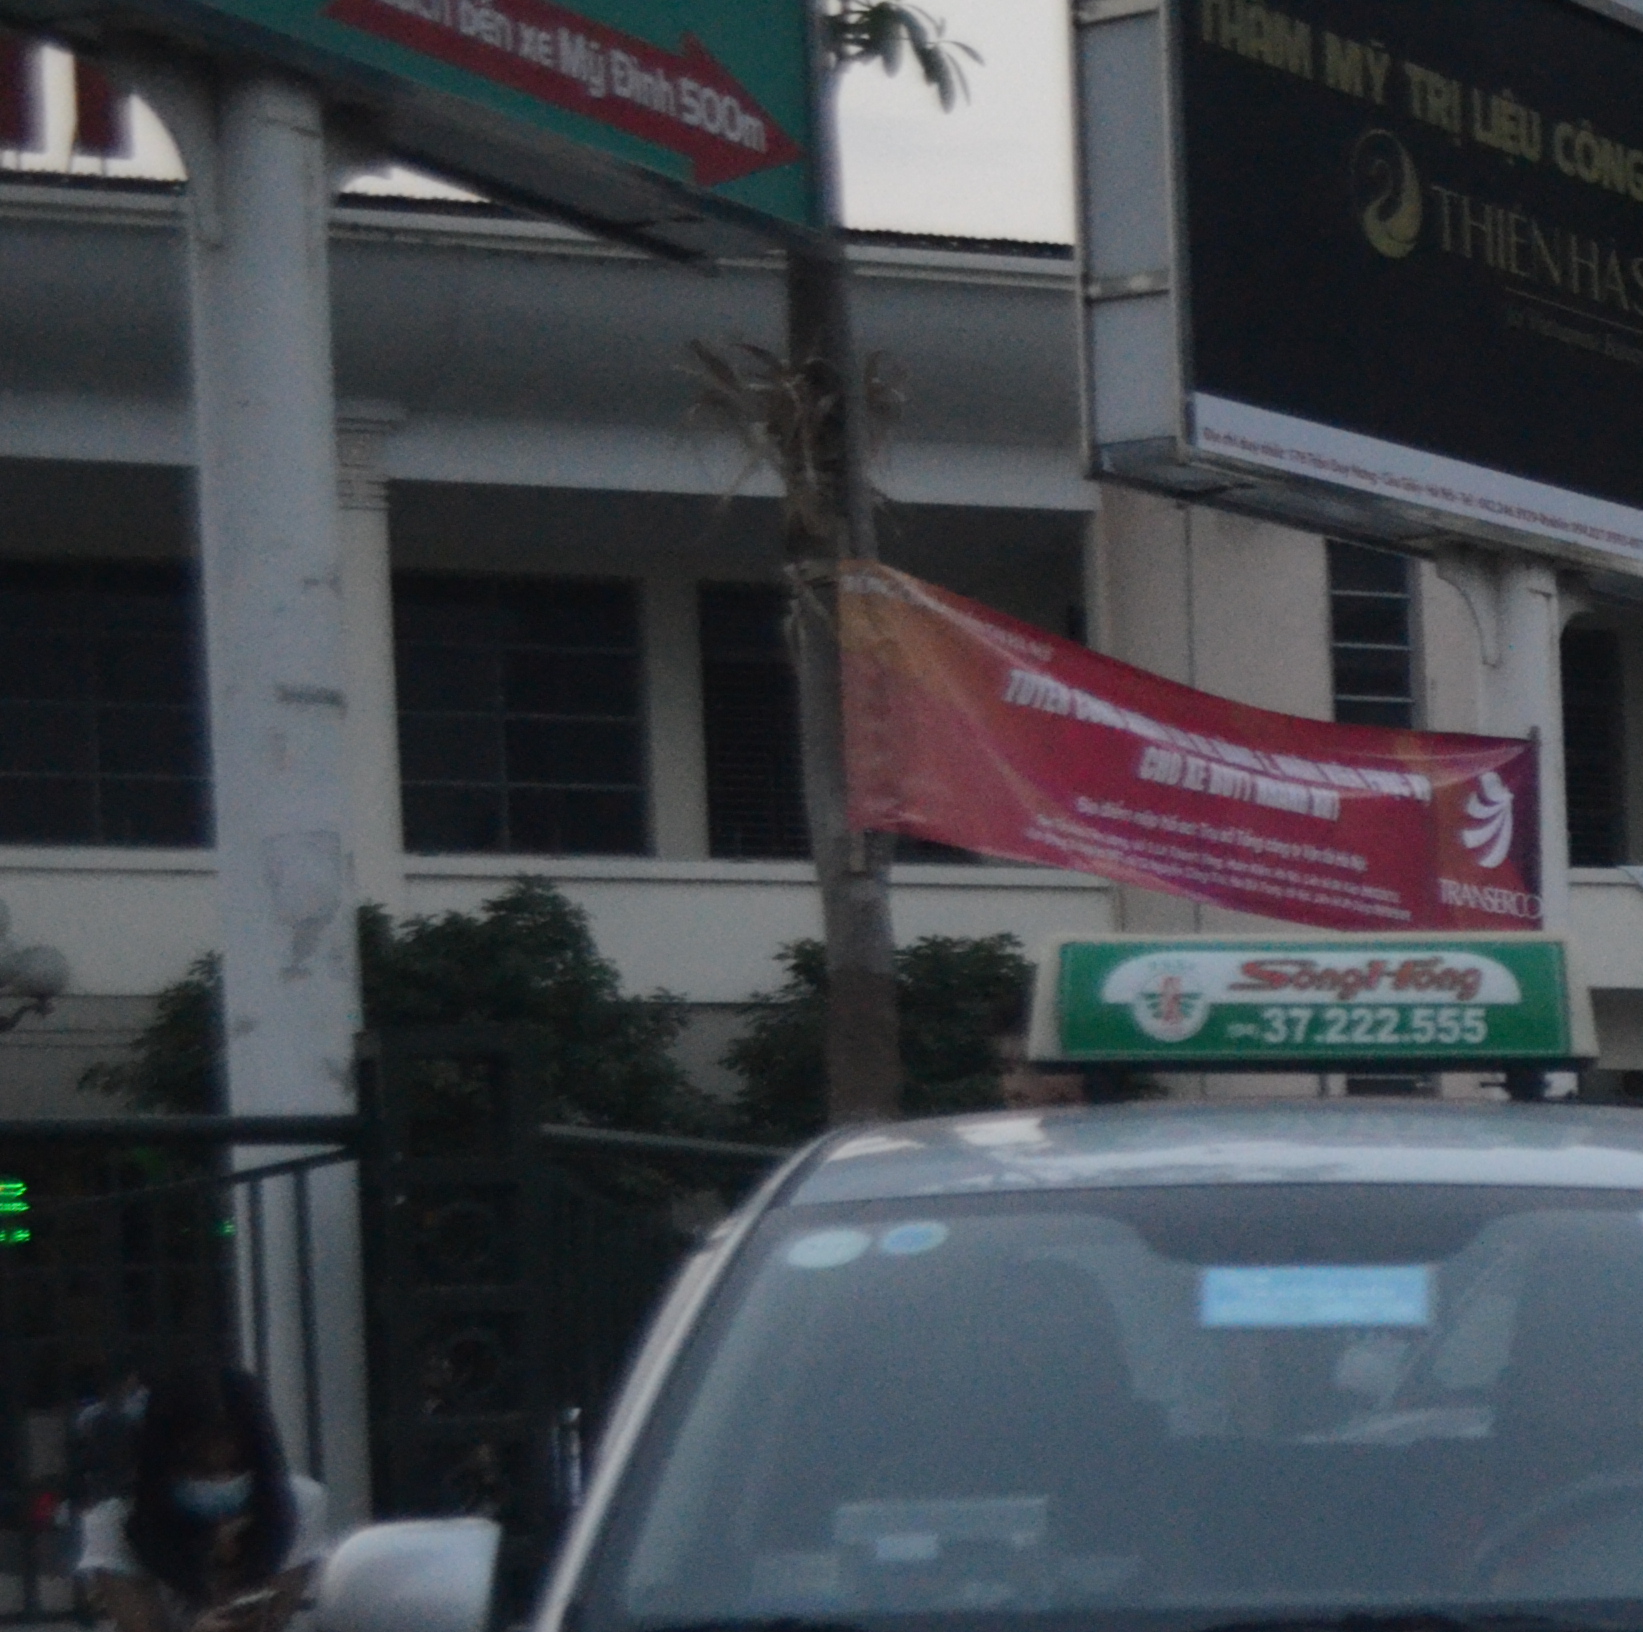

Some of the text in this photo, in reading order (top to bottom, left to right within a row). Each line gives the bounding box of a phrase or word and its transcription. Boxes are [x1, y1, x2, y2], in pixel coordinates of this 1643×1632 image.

[609, 48, 677, 117] Đình
[678, 76, 767, 153] 500m
[1403, 60, 1463, 148] TRỊ
[1471, 86, 1542, 168] LIỆU
[1437, 877, 1543, 920] TRANSERCO
[1261, 1006, 1488, 1045] 37.222.555
